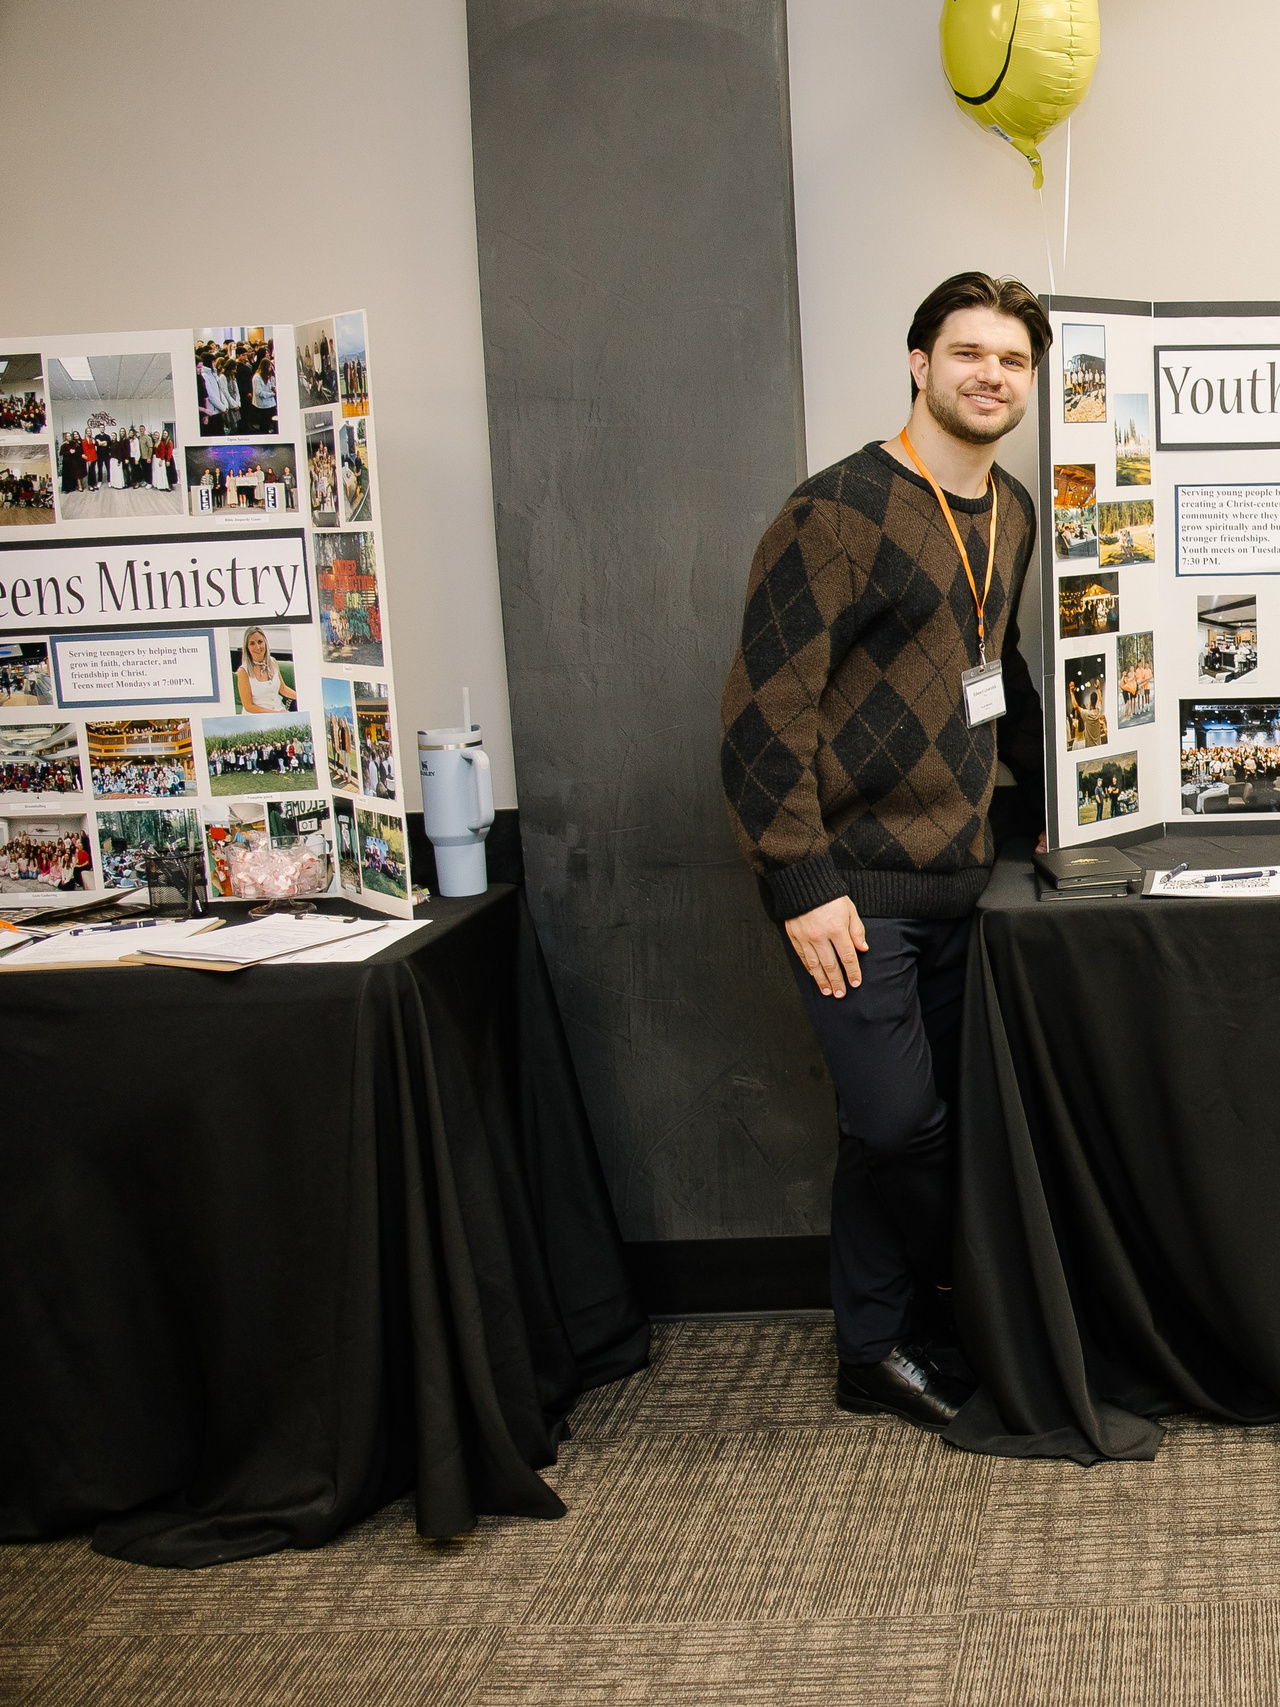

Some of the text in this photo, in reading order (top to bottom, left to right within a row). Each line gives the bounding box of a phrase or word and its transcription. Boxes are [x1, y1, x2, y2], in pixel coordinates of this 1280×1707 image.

[1181, 489, 1214, 498] Serving
[1217, 490, 1243, 498] young
[1245, 489, 1273, 498] people
[1181, 500, 1216, 509] creating
[1181, 512, 1229, 521] community
[1261, 512, 1278, 521] they
[1205, 523, 1249, 532] spiritually
[1252, 523, 1268, 531] and
[1181, 535, 1270, 544] stronger friendships.
[1182, 546, 1208, 554] Youth
[1182, 557, 1221, 565] 7:30 PM.
[95, 556, 300, 617] Ministry
[69, 650, 98, 658] Serving
[100, 649, 135, 657] teenagers
[137, 648, 147, 656] by
[149, 647, 177, 655] helping
[101, 660, 121, 668] faith,
[122, 658, 161, 667] character,
[162, 657, 177, 665] and
[71, 671, 109, 680] friendship
[121, 669, 147, 678] Christ.
[72, 678, 195, 690] Teens meet Mondays at 7:00PM.
